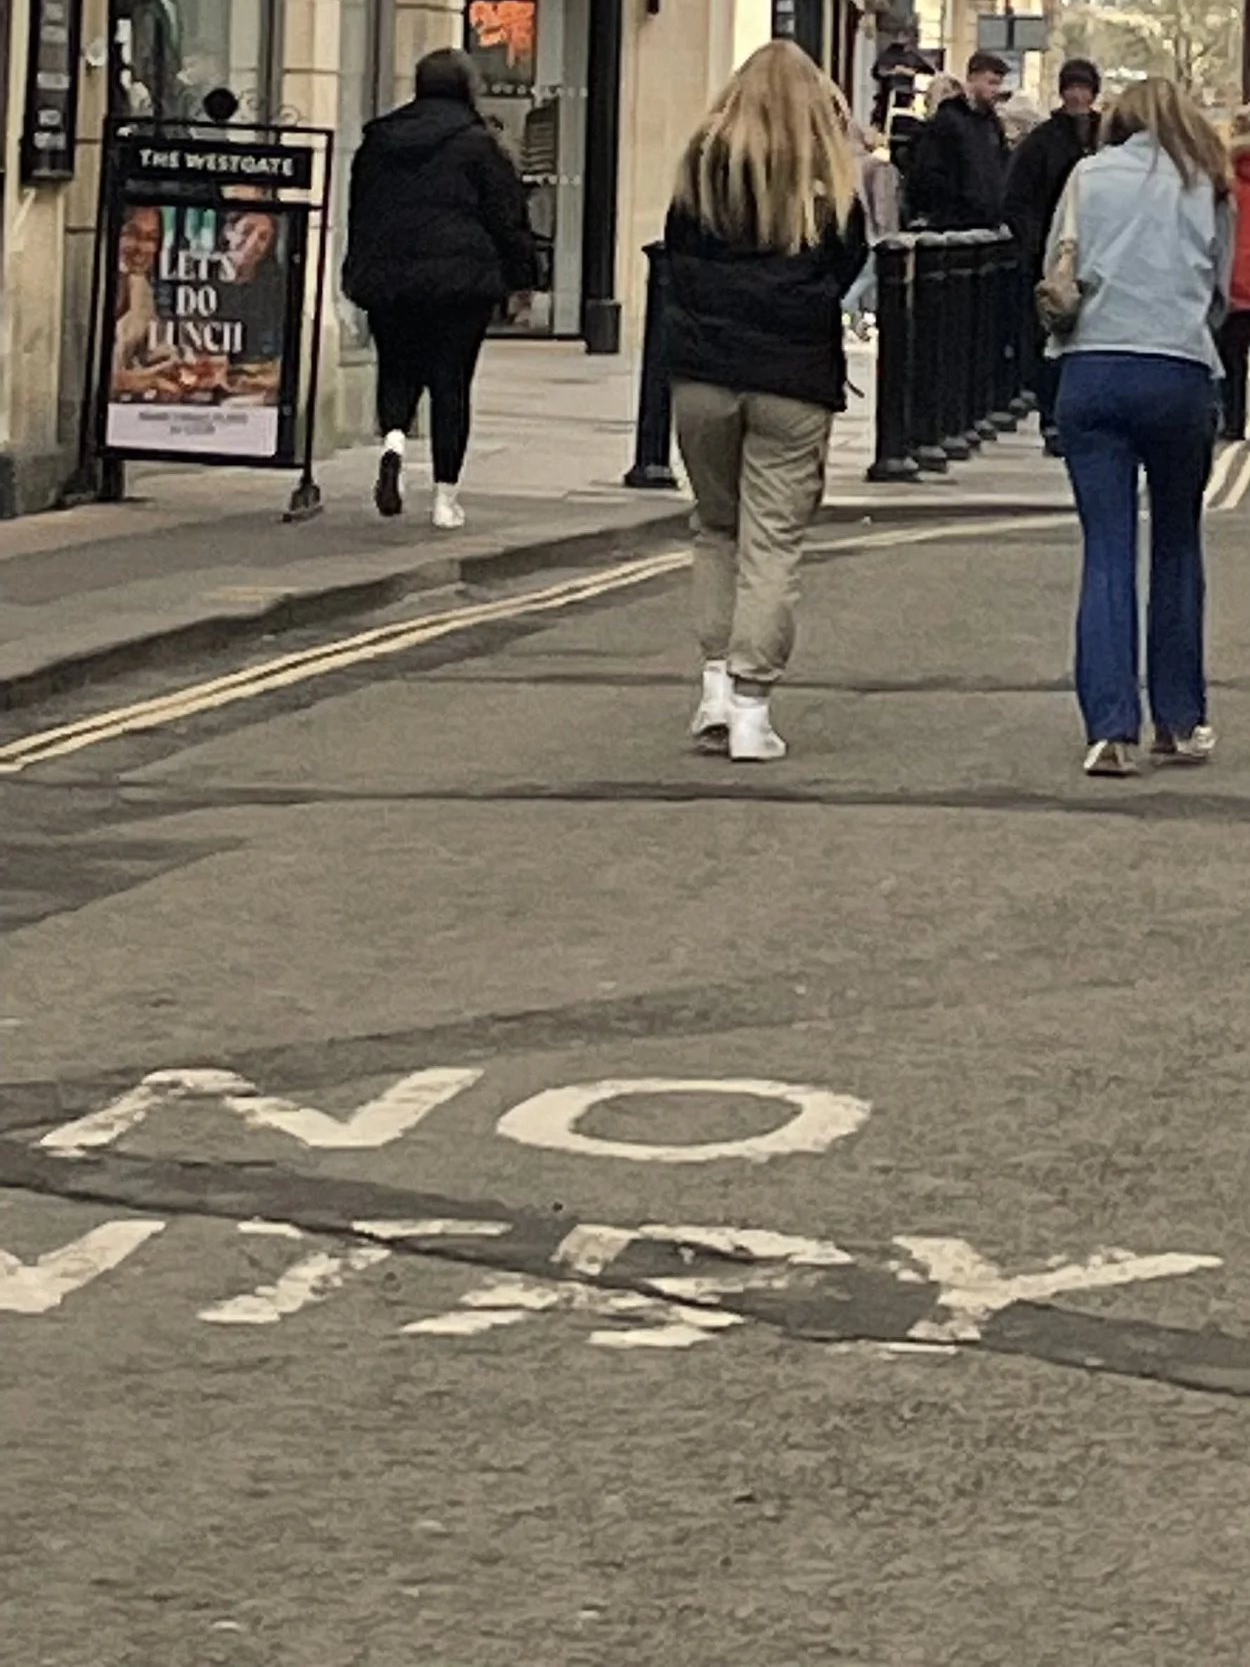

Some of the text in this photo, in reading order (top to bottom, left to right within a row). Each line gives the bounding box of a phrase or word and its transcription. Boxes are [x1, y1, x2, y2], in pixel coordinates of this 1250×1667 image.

[139, 149, 295, 177] THE WESTGATE
[160, 247, 238, 282] LET'S
[175, 285, 218, 318] DO
[147, 319, 243, 354] LUNCH
[35, 1067, 873, 1162] NO
